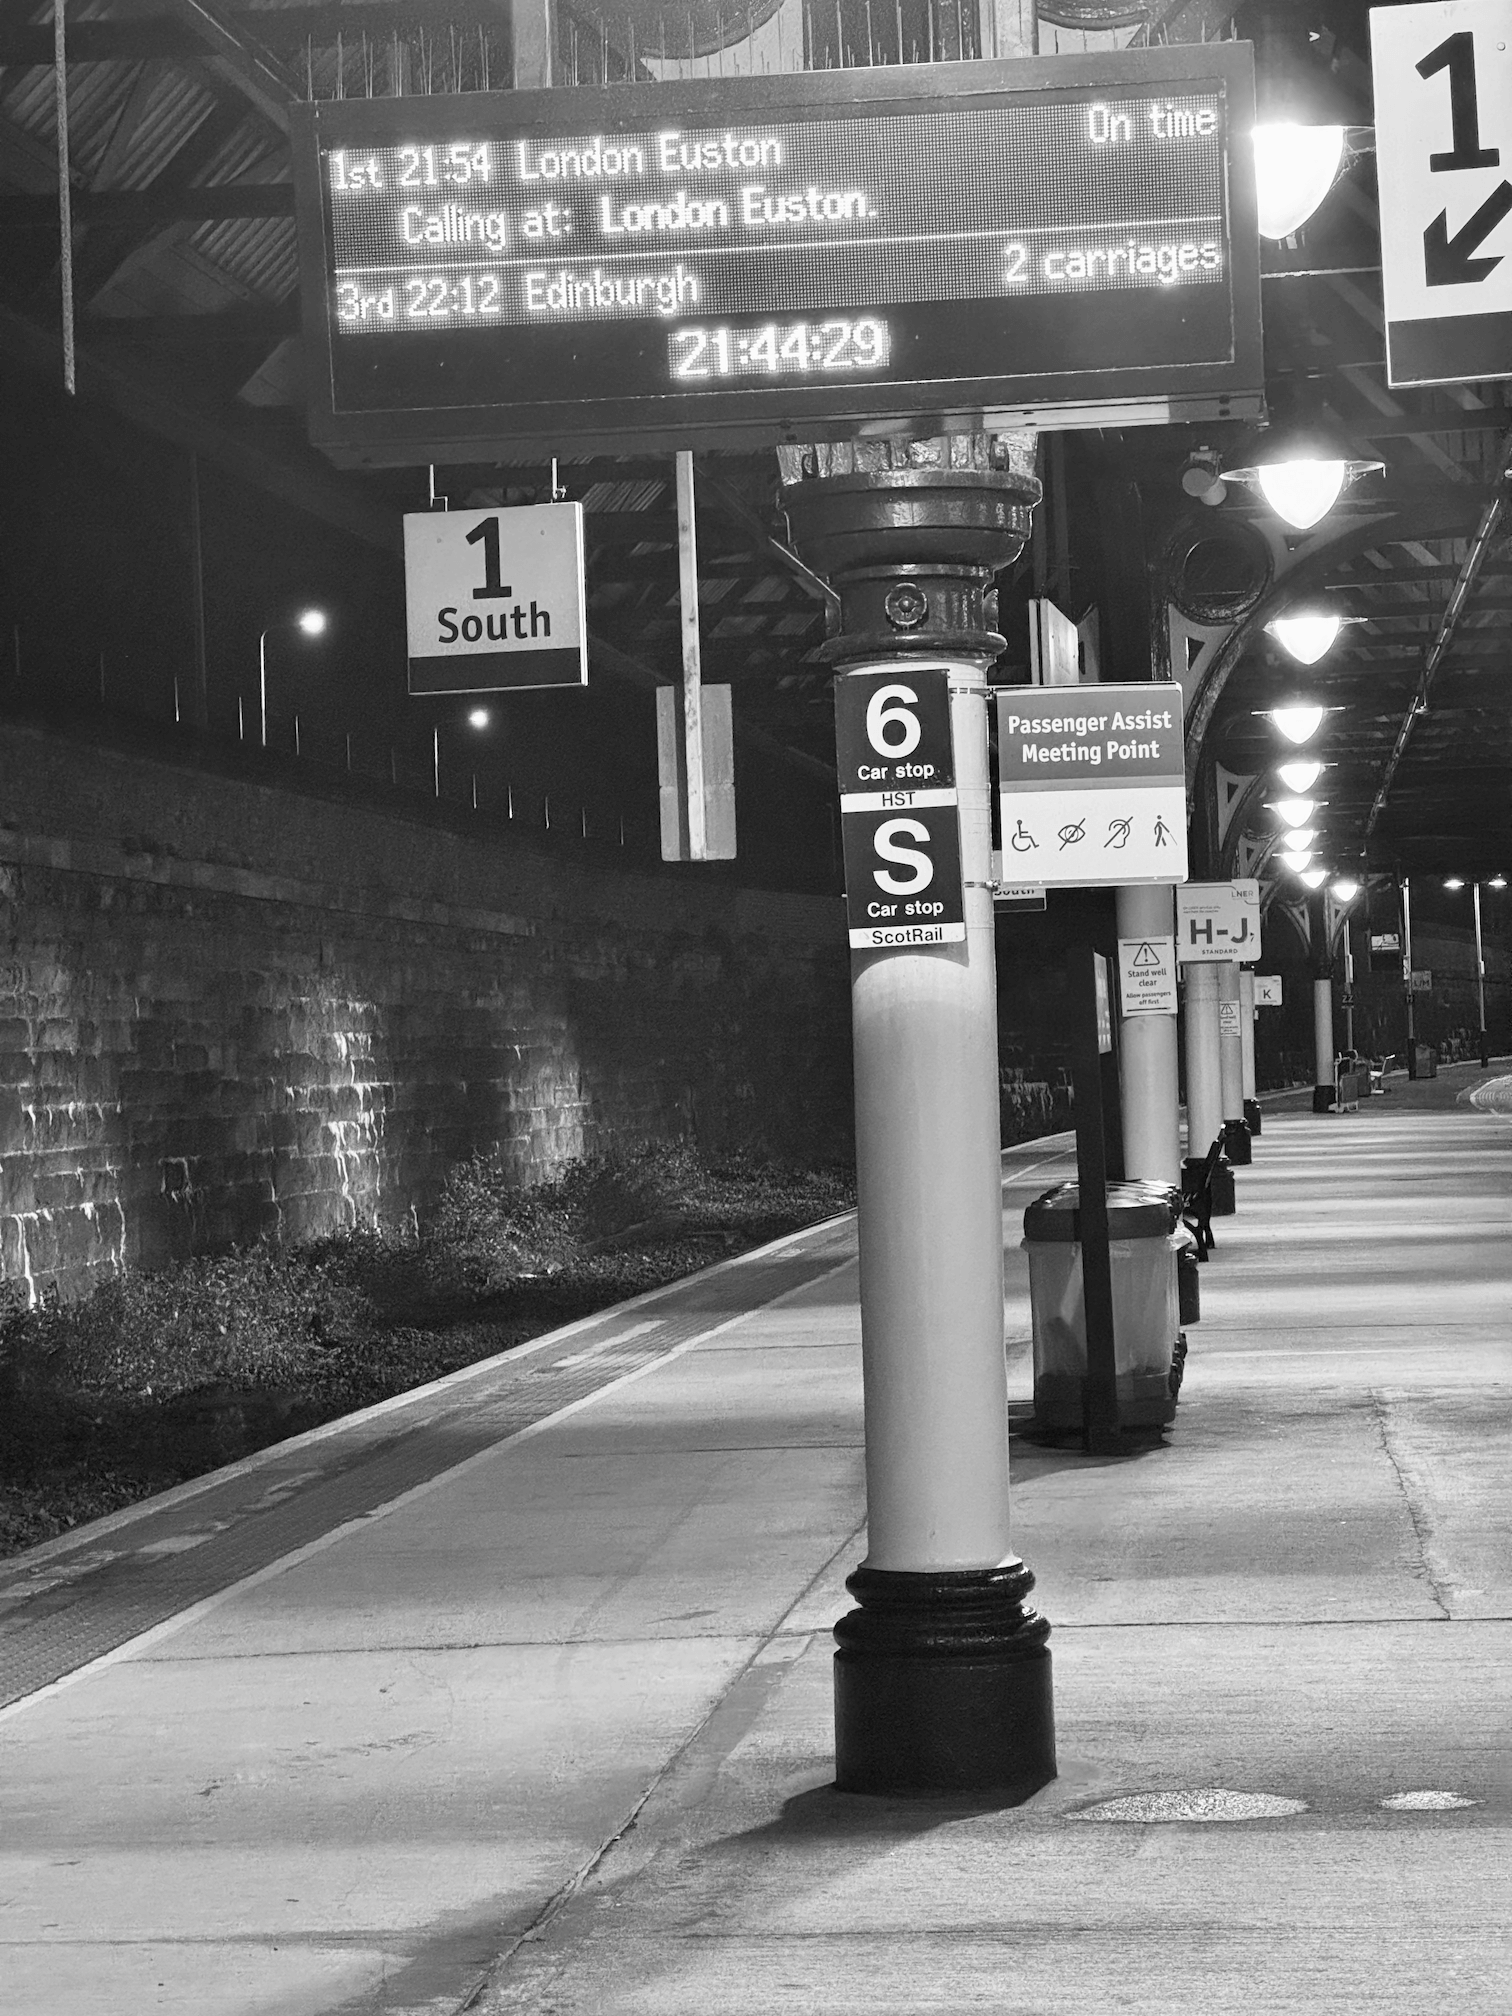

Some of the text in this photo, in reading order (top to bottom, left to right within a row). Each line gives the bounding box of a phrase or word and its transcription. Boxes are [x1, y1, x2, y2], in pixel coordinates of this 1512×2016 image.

[1414, 31, 1500, 173] 1
[1087, 103, 1217, 143] On time
[335, 131, 782, 190] 1st 21:54 London Euston
[401, 185, 879, 251] Calling at: London Euston.
[1004, 239, 1222, 286] 2 carriages
[338, 265, 700, 322] 3rd 22:12 Edinburgh
[674, 318, 884, 379] 21:44:29
[465, 516, 512, 600] 1
[438, 601, 551, 644] South
[866, 684, 922, 759] 6
[1008, 710, 1172, 736] Passenger Assist
[1022, 739, 1160, 766] Meeting Point
[857, 762, 935, 781] Car stop
[881, 791, 916, 807] HST
[873, 817, 934, 896] S
[867, 900, 944, 918] Car stop
[1231, 890, 1254, 898] LNER
[872, 926, 943, 946] ScotRail
[1127, 968, 1167, 978] Stand well
[1138, 978, 1157, 987] clear
[1142, 991, 1172, 1000] passengers
[1263, 988, 1272, 1000] K
